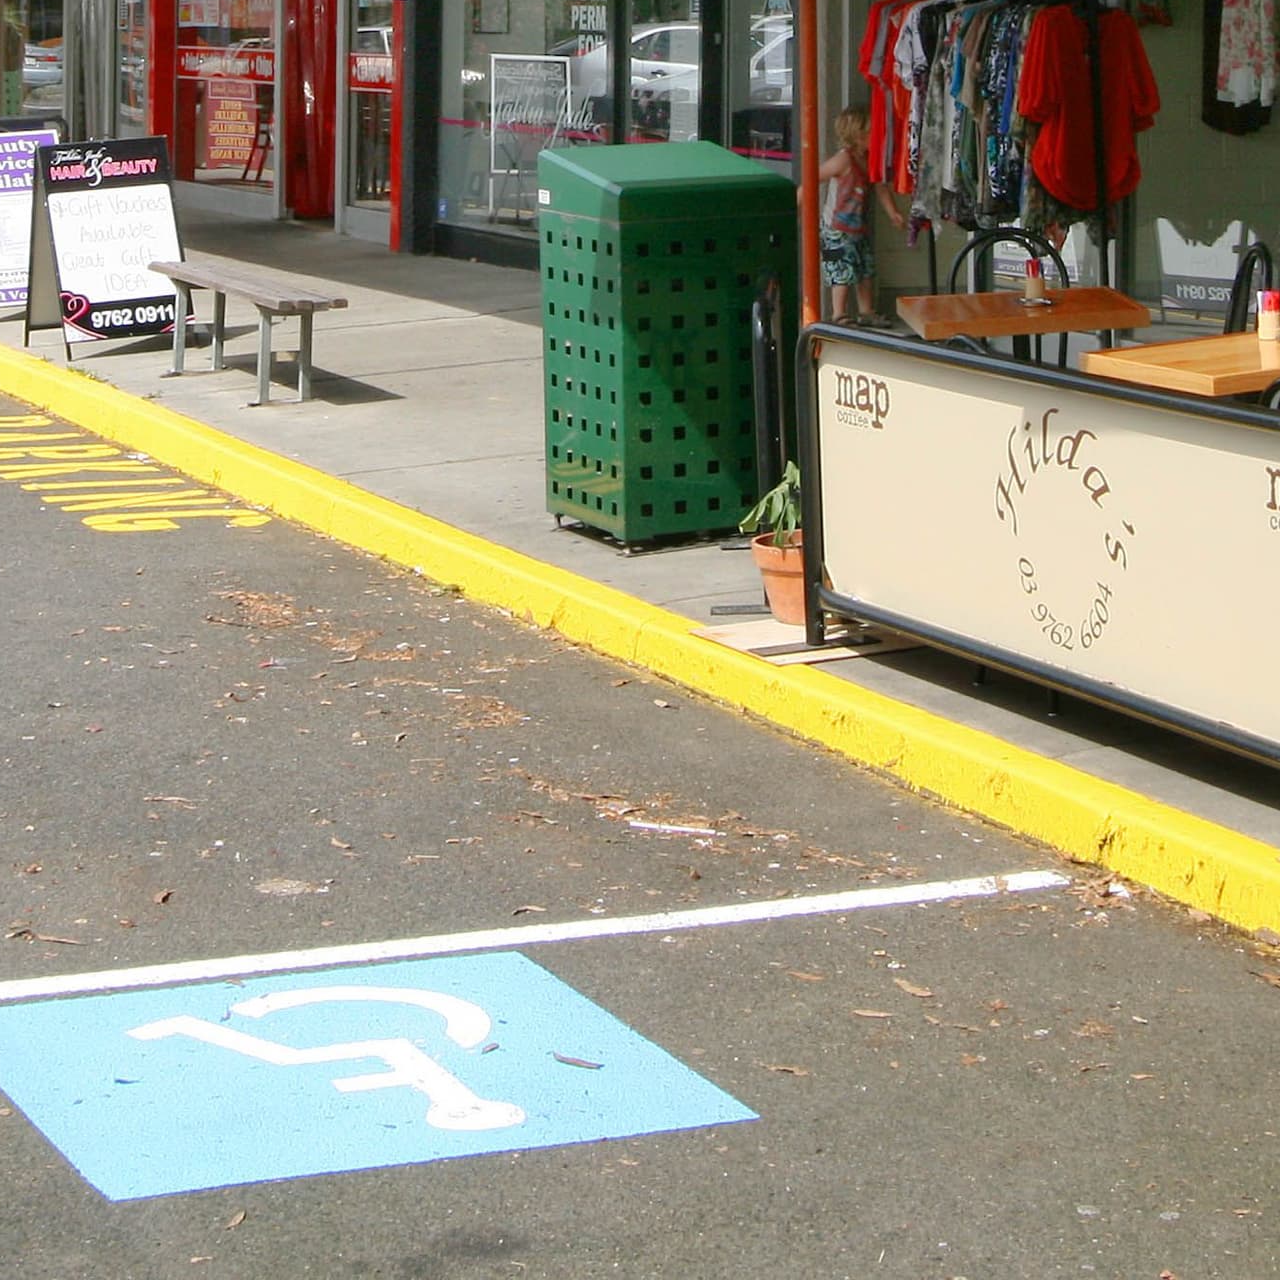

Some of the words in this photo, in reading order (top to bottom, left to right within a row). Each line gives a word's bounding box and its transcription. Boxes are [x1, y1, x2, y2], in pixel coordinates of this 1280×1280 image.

[50, 163, 87, 180] HAIR
[102, 159, 157, 177] BEAUTY
[91, 307, 135, 329] 9762
[135, 303, 175, 324] 0911
[834, 369, 890, 428] map
[836, 409, 869, 428] coffee
[995, 408, 1135, 571] Hilda's
[1018, 557, 1037, 595] 03
[1030, 602, 1074, 652] 9762
[1080, 581, 1113, 649] 6604
